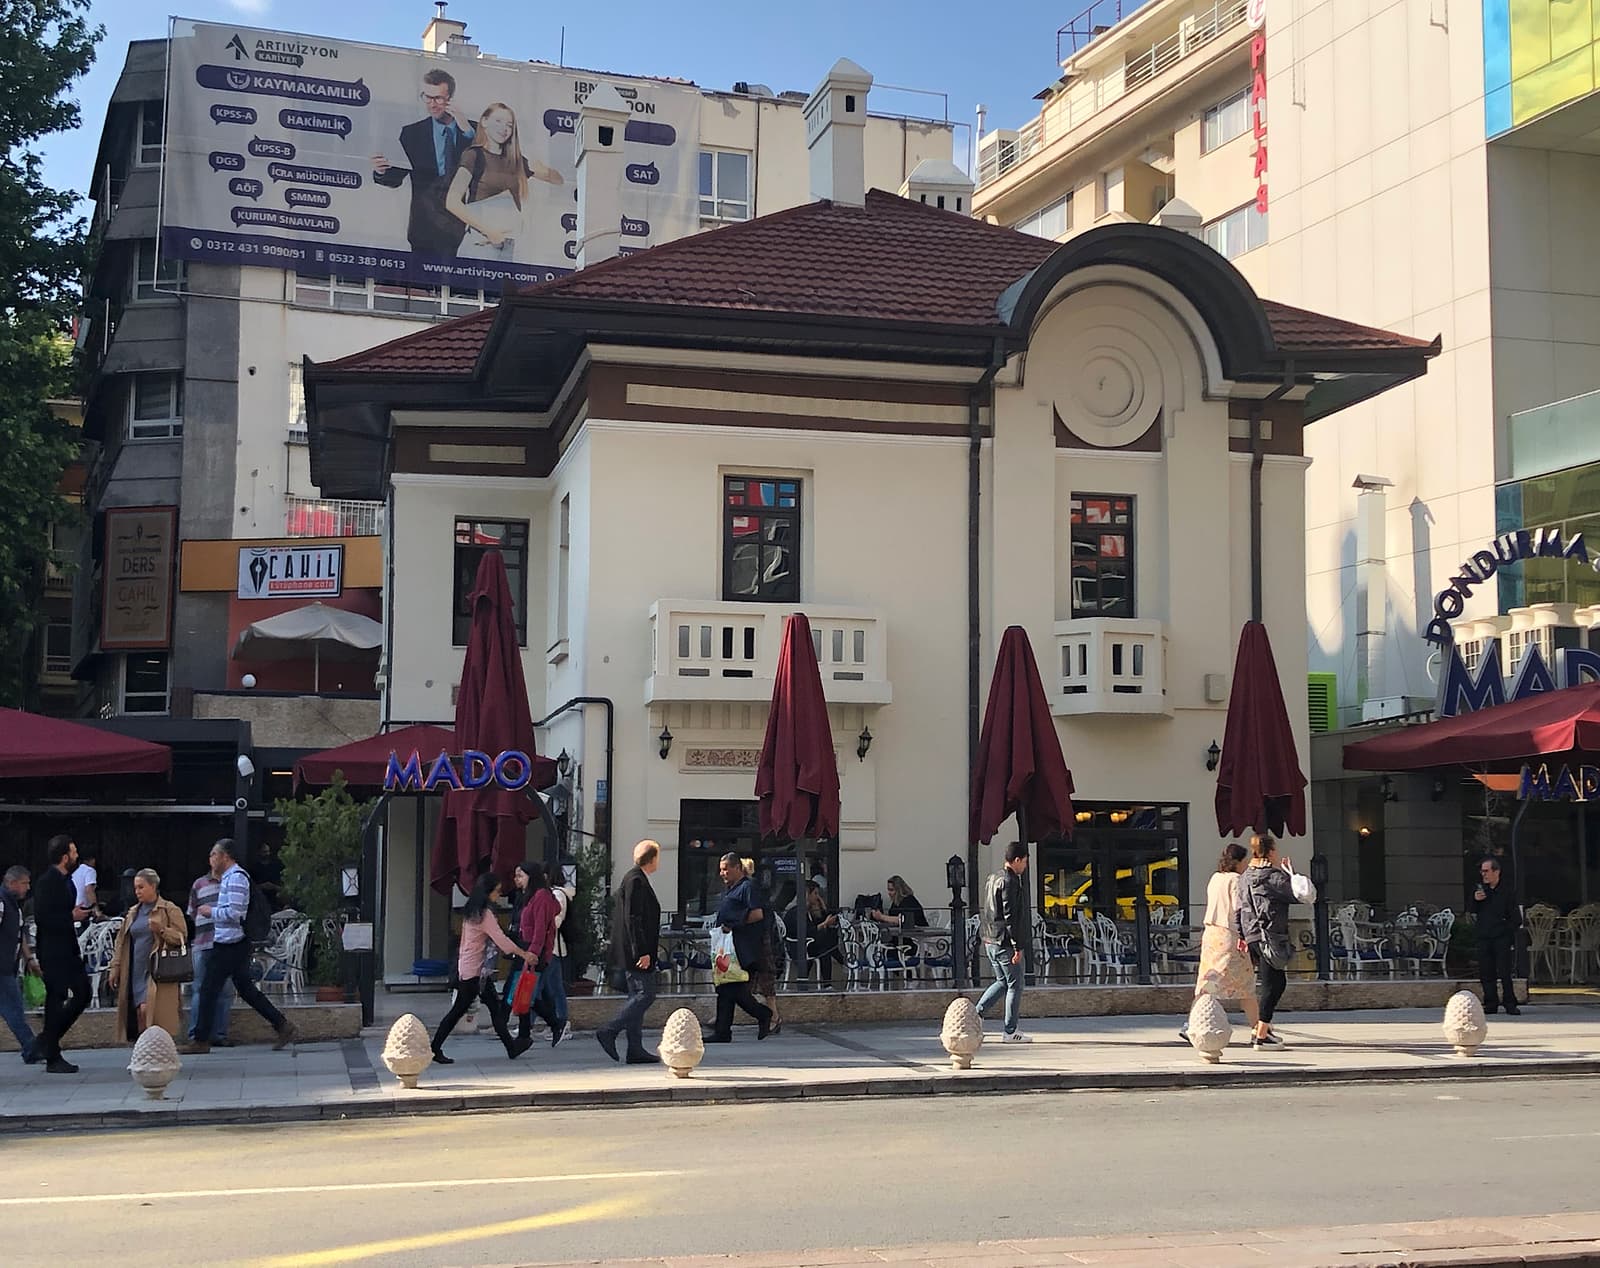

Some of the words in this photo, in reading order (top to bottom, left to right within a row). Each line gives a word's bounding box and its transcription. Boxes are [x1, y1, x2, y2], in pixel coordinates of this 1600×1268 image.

[254, 77, 362, 100] KAYMAKAMLIK
[216, 108, 253, 121] KPSS-A
[287, 114, 346, 131] HAKİMLİK
[254, 143, 291, 156] KPSS-B
[215, 155, 239, 166] DGS
[296, 169, 358, 186] MÜDÜRLÜĞÜ
[633, 168, 654, 180] SAT
[235, 182, 258, 193] AÖF
[290, 192, 327, 204] SMMM
[237, 210, 277, 223] KURUM
[279, 215, 335, 230] SINAVLARI
[623, 222, 643, 232] YDS
[207, 240, 235, 252] 0312
[238, 243, 259, 254] 431
[329, 254, 355, 264] 0532
[357, 256, 377, 266] 383
[380, 258, 406, 269] 0613
[122, 556, 155, 574] DERS
[383, 748, 532, 792] MADO
